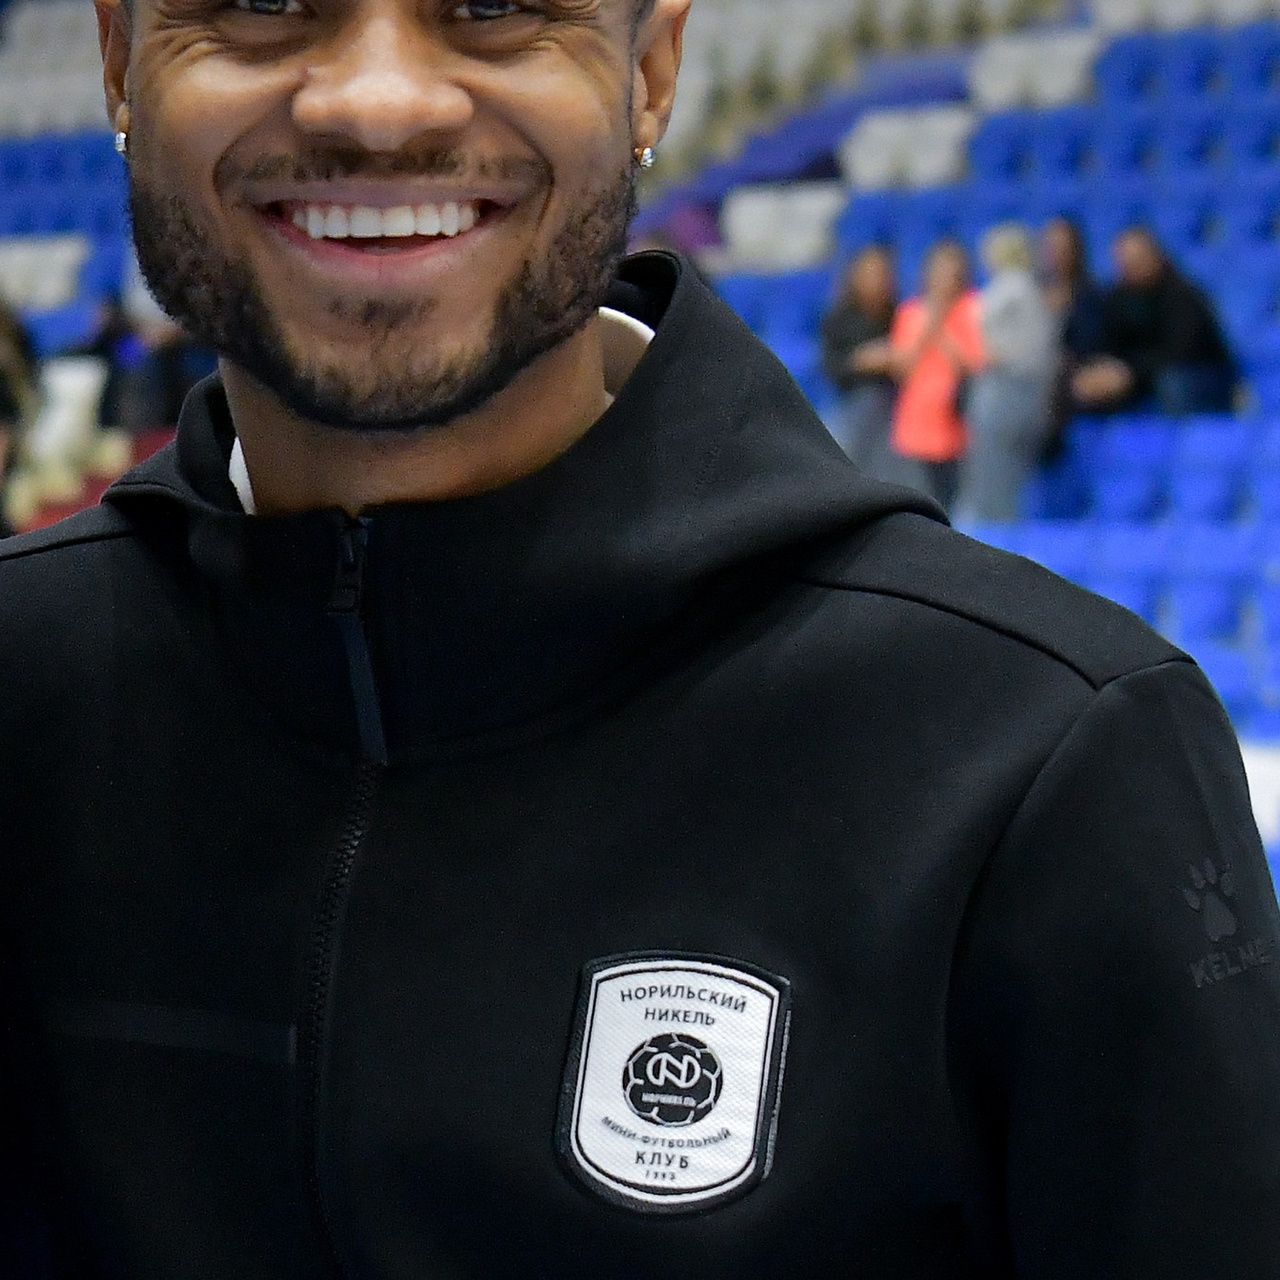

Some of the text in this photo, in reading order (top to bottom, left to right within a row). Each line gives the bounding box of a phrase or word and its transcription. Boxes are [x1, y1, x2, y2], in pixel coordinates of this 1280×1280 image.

[620, 984, 747, 1013] НОРИЛЬСКИЙ
[644, 1007, 716, 1026] НИКЕЛЬ
[600, 1116, 732, 1148] МИНИ-ФУТБОЛЬНЫЙ
[635, 1151, 689, 1169] КЛУБ
